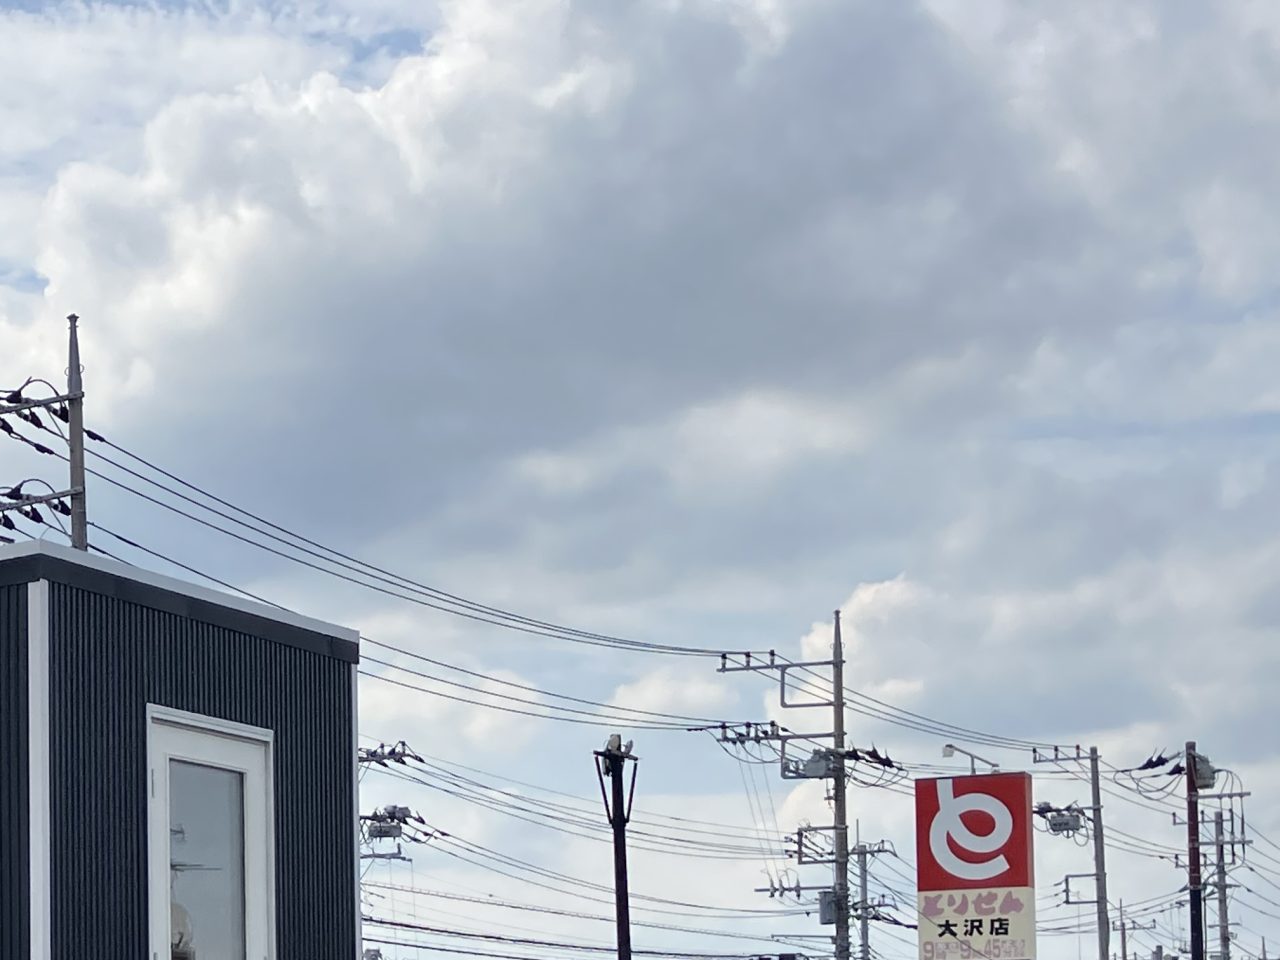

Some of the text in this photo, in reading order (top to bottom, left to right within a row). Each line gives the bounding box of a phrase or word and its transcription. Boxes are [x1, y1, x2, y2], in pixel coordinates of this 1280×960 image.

[922, 890, 1024, 916] とりせん
[937, 917, 1010, 938] 大沢店
